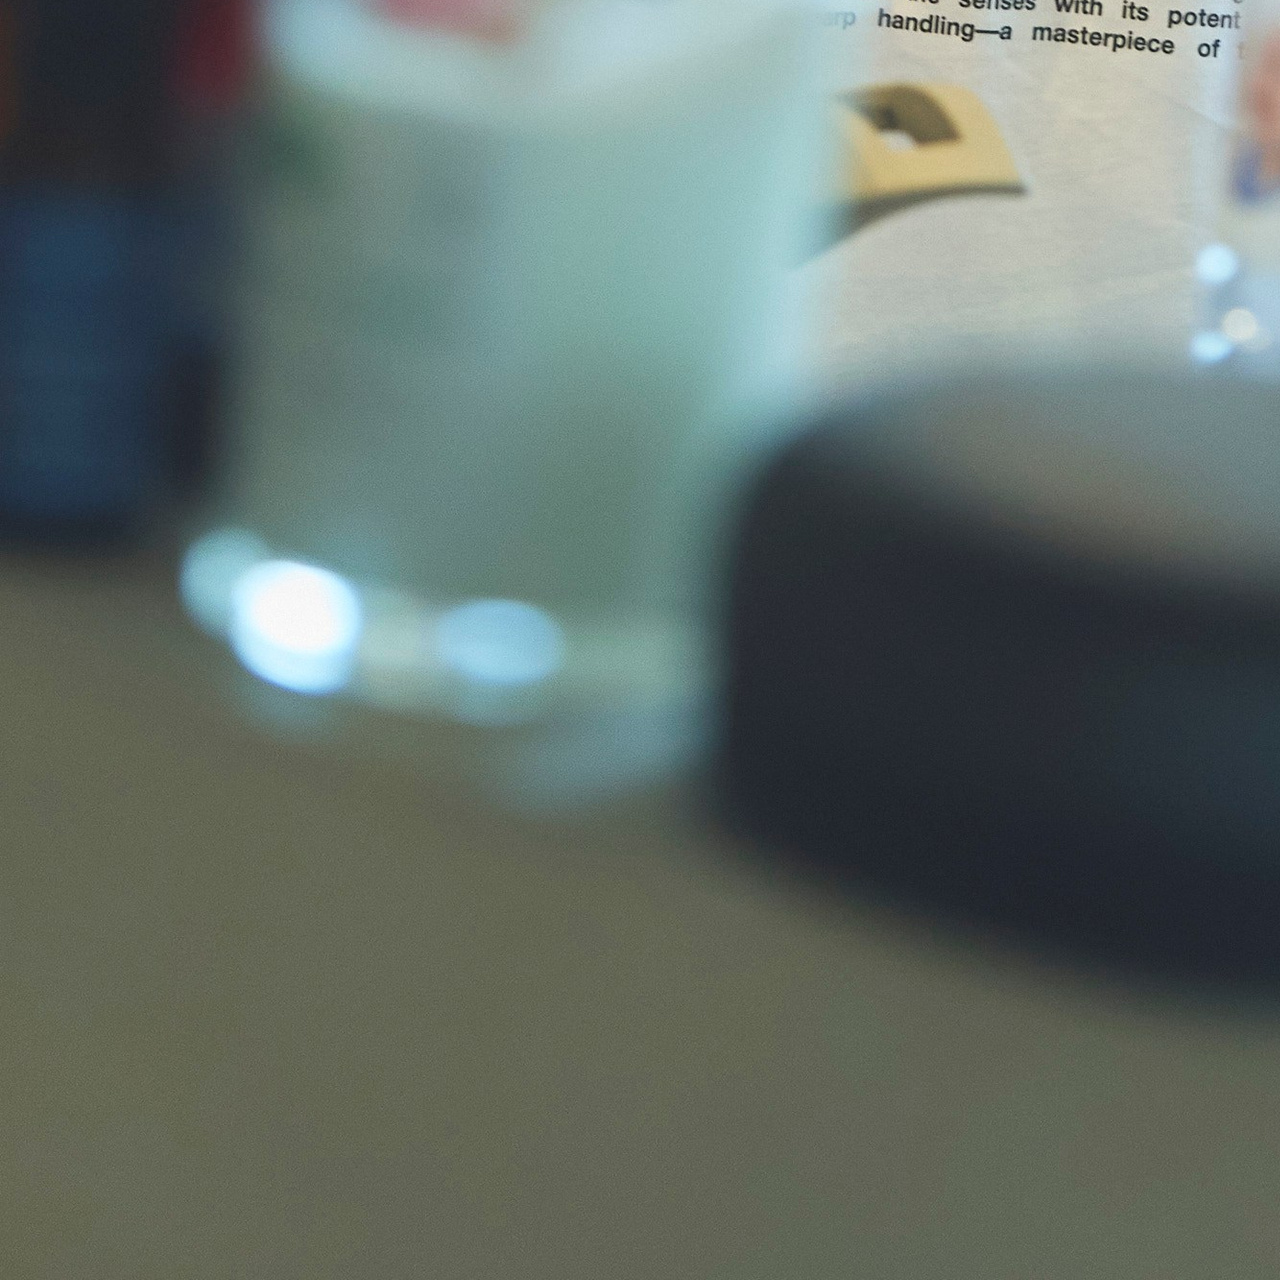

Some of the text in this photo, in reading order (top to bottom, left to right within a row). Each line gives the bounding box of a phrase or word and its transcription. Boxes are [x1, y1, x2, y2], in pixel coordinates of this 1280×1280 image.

[1122, 0, 1150, 21] its
[1032, 22, 1176, 55] masterpiece
[1198, 39, 1221, 59] of
